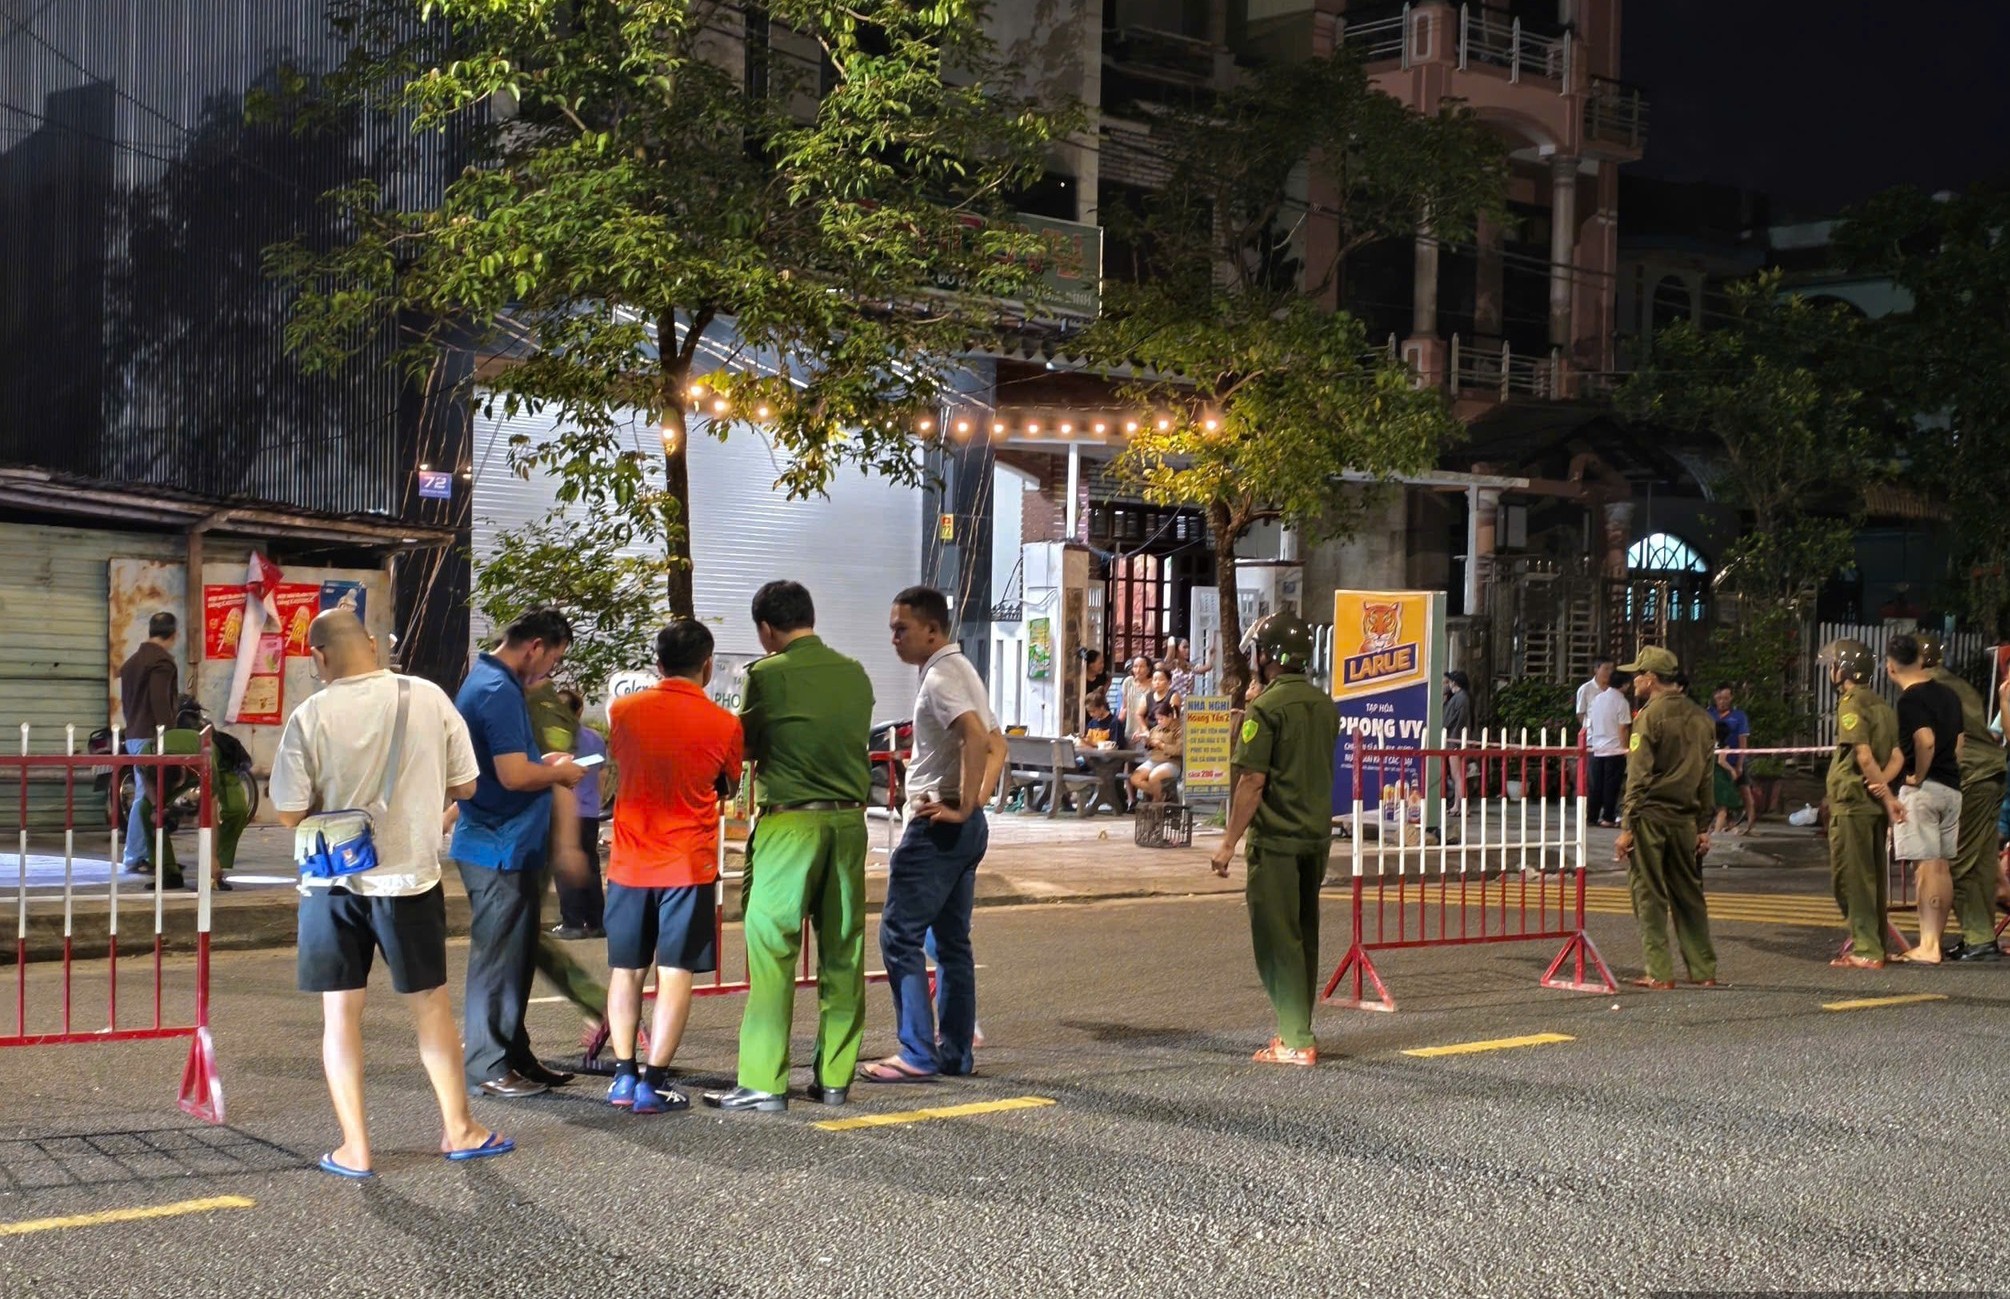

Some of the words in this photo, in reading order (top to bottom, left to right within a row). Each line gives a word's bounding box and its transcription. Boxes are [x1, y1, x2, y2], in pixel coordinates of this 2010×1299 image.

[423, 476, 447, 489] 72
[1350, 647, 1410, 681] LARUE
[1338, 716, 1395, 738] PHONG
[1399, 720, 1423, 739] VY
